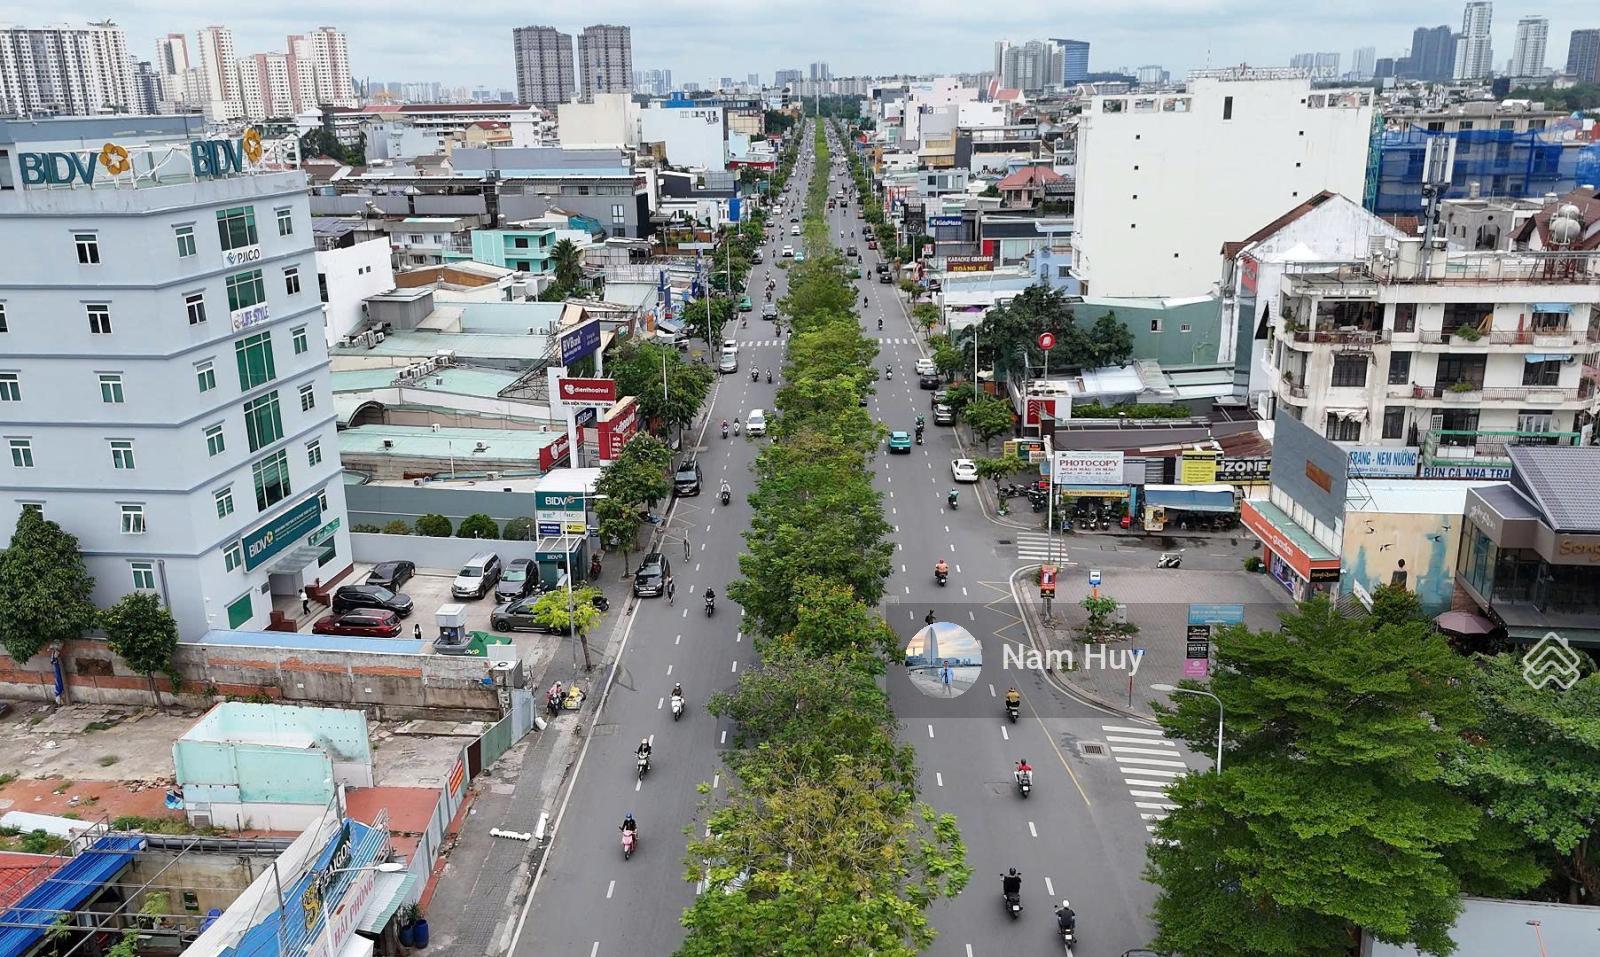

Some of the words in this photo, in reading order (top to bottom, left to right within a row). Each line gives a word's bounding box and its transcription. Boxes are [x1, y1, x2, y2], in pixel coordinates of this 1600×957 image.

[191, 139, 243, 177] BIDV
[18, 152, 98, 184] BIDV
[237, 249, 260, 264] PJICO
[1377, 451, 1392, 466] NEM
[1393, 448, 1416, 467] NƯỚNG
[1220, 461, 1268, 472] iZONE
[1465, 468, 1486, 478] NHA
[545, 497, 567, 505] BIDV
[249, 535, 268, 558] BIDV
